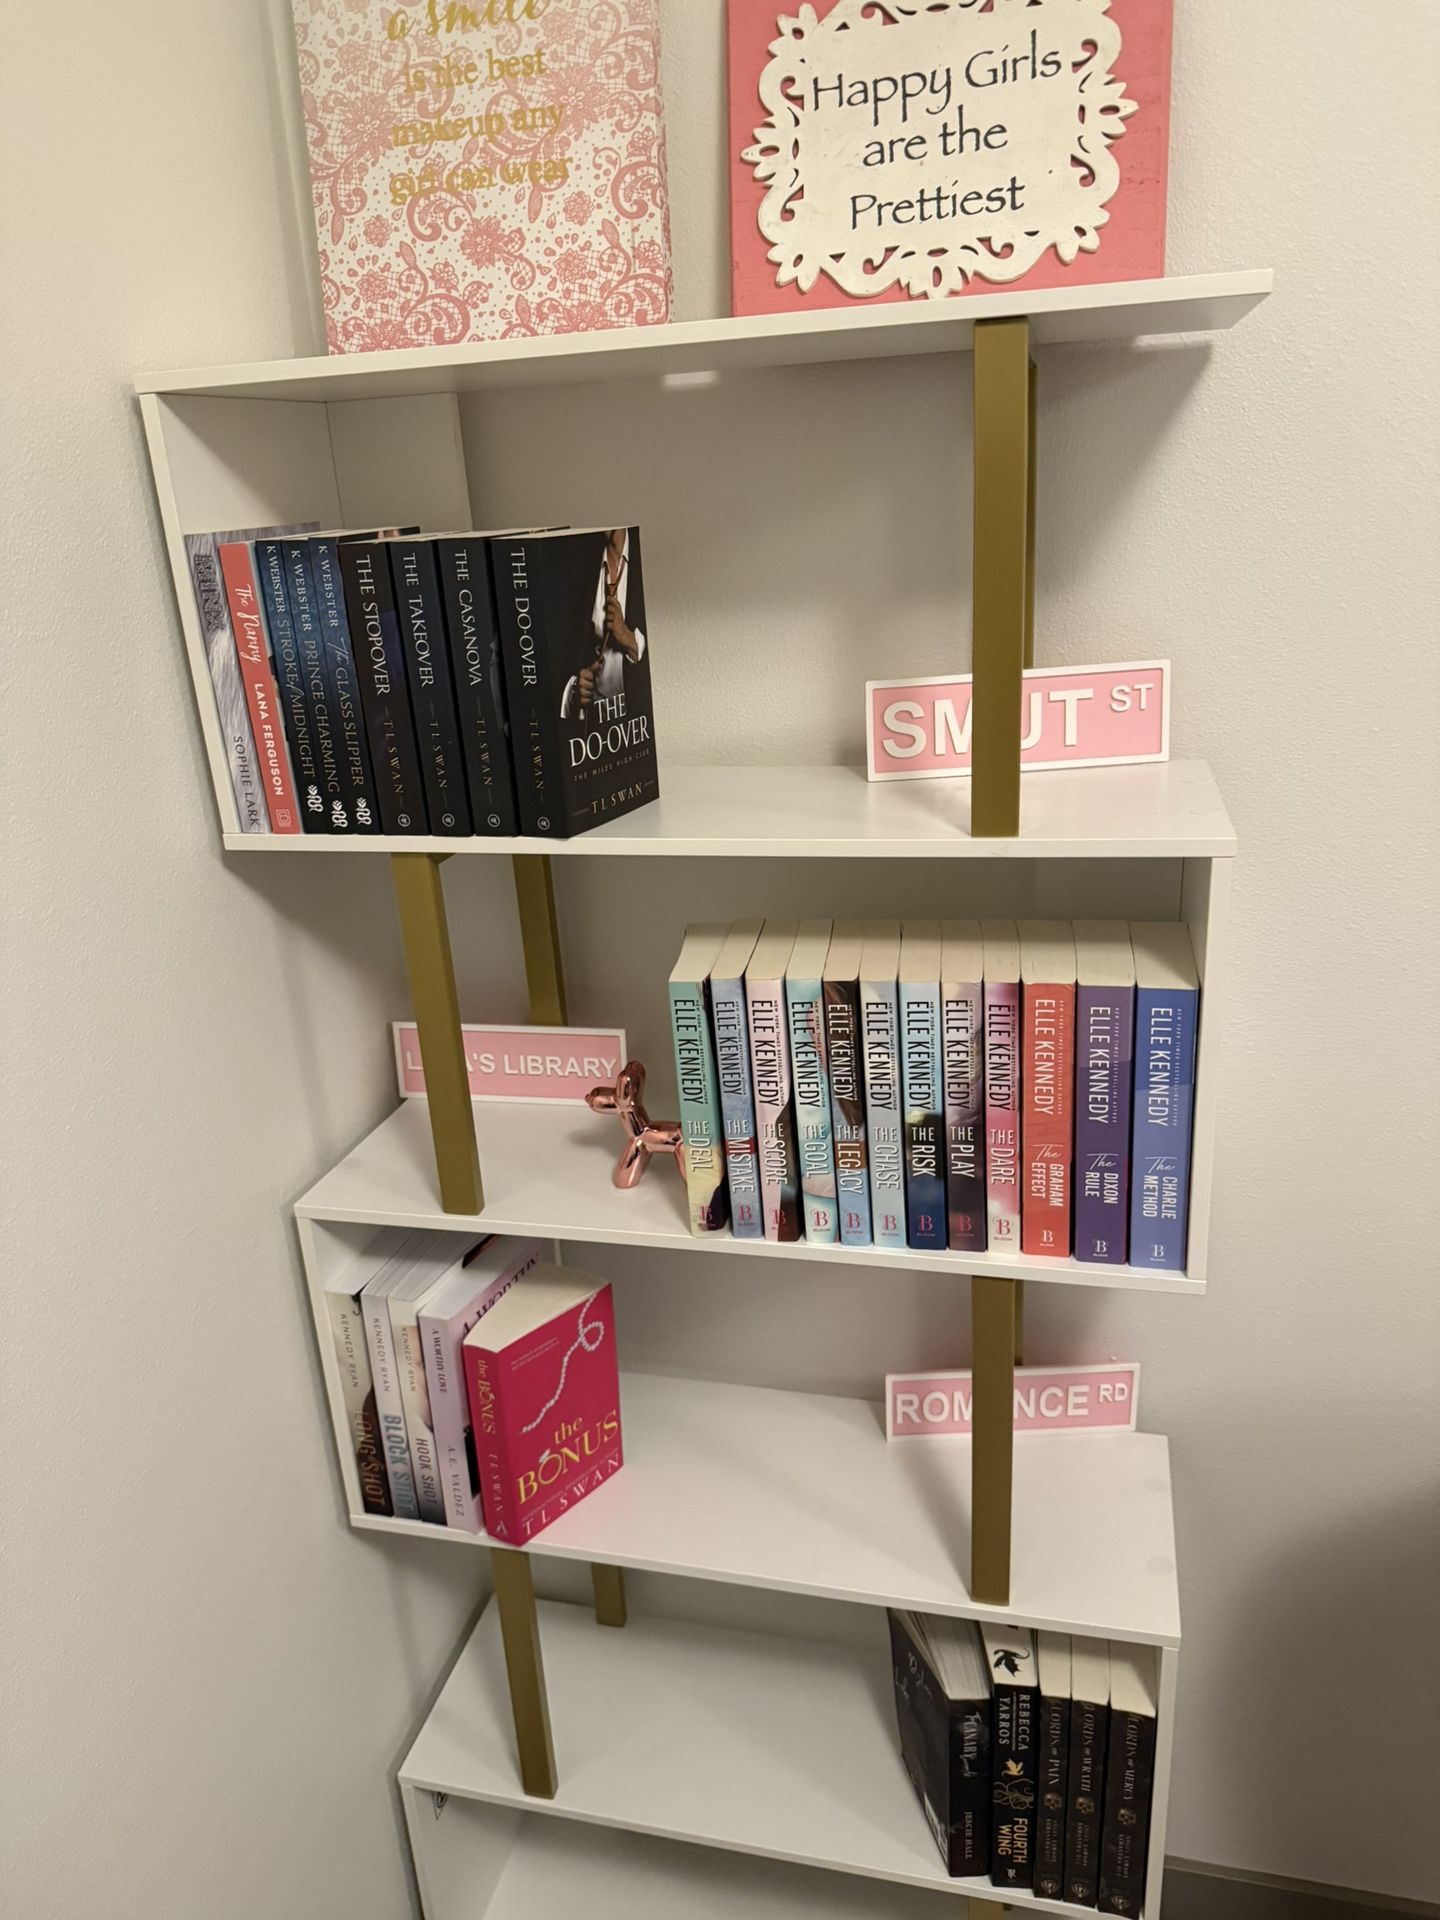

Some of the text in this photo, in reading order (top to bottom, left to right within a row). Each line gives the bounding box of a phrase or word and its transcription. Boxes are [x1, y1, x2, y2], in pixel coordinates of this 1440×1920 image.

[387, 9, 417, 41] a
[403, 48, 547, 93] is the best
[812, 28, 1062, 126] Happy Girls
[391, 104, 566, 148] makeup any
[863, 104, 1009, 168] are the
[445, 165, 496, 195] can
[498, 155, 572, 186] wear
[850, 175, 1025, 230] Prettiest
[318, 545, 328, 555] K
[403, 552, 420, 587] THE
[455, 549, 470, 582] THE
[510, 547, 529, 590] THE
[320, 558, 340, 628] WEBSTER
[356, 554, 376, 596] THE
[235, 583, 263, 664] The Nanny
[408, 594, 435, 688] TAKEOVER
[459, 589, 483, 687] CASANOVA
[514, 597, 538, 688] DO-OVER
[266, 545, 316, 779] K WEBSTER STROKE MIDNIGHT
[291, 550, 341, 794] K WEBSTER PRINCE CHARMING
[363, 601, 392, 697] STOPOVER
[335, 667, 355, 720] GLASS
[594, 693, 627, 724] THE
[1109, 682, 1155, 713] ST
[254, 683, 286, 797] LANA FERGUSON
[343, 722, 366, 787] SLIPPER
[568, 715, 651, 768] DO-OVER
[233, 736, 261, 827] SOPHIE LARK
[388, 746, 405, 794] SWAN
[433, 744, 449, 789] SWAN
[479, 742, 494, 787] SWAN
[531, 745, 546, 790] SWAN
[611, 782, 643, 807] SWAN
[503, 1054, 617, 1079] LIBRARY
[674, 999, 705, 1106] ELLE KENNEDY
[715, 1001, 743, 1097] ELLE KENNEDY
[752, 1000, 781, 1107] ELLE KENNEDY
[791, 1001, 821, 1108] ELLE KENNEDY
[828, 1004, 855, 1102] ELLE KENNEDY
[865, 1002, 893, 1111] ELLE KENNEDY
[906, 1001, 932, 1110] ELLE KENNEDY
[945, 1000, 971, 1110] ELLE KENNEDY
[988, 1004, 1012, 1111] ELLE KENNEDY
[1034, 999, 1056, 1116] ELLE KENNEDY
[1088, 1006, 1111, 1124] ELLE KENNEDY
[1148, 1007, 1173, 1127] ELLE KENNEDY
[687, 1120, 711, 1136] THE
[726, 1119, 750, 1135] THE
[762, 1123, 785, 1138] THE
[803, 1123, 827, 1140] THE
[836, 1125, 860, 1140] THE
[873, 1127, 898, 1143] THE
[911, 1127, 936, 1142] THE
[950, 1126, 974, 1142] THE
[990, 1129, 1015, 1145] THE
[688, 1137, 714, 1173] DEAL
[727, 1136, 756, 1194] MISTAKE
[763, 1140, 789, 1187] SCORE
[804, 1141, 831, 1179] GOAL
[837, 1141, 865, 1196] LEGACY
[874, 1144, 900, 1191] CHASE
[911, 1144, 937, 1178] RISK
[950, 1144, 976, 1179] PLAY
[991, 1147, 1016, 1186] DARE
[1032, 1144, 1064, 1162] The
[1086, 1153, 1119, 1171] The
[1144, 1156, 1178, 1174] The
[1031, 1162, 1046, 1199] EFFECT
[1049, 1163, 1065, 1208] GRAHAM
[1085, 1171, 1100, 1198] RULE
[1103, 1172, 1119, 1205] DIXON
[1142, 1175, 1158, 1218] METHOD
[1161, 1176, 1178, 1220] CHARLIE
[340, 1313, 359, 1389] KENNEDY RYAN
[373, 1318, 392, 1393] KENNEDY RYAN
[401, 1327, 417, 1392] KENNEDY RYAN
[478, 1379, 497, 1436] BONUS
[896, 1382, 1129, 1425] ROMNCE RD
[554, 1416, 583, 1446] the
[354, 1411, 386, 1506] LONG SHOT
[383, 1414, 415, 1511] BLOCK SHOT
[416, 1438, 438, 1505] HOOK SHOT
[516, 1410, 619, 1505] BONUS
[450, 1473, 466, 1517] VALDEZ
[522, 1453, 620, 1536] T L SWAN
[998, 1697, 1011, 1745] YARROS
[1018, 1694, 1030, 1750] REBECCA
[998, 1824, 1012, 1856] WING
[1013, 1817, 1028, 1863] FOURTH
